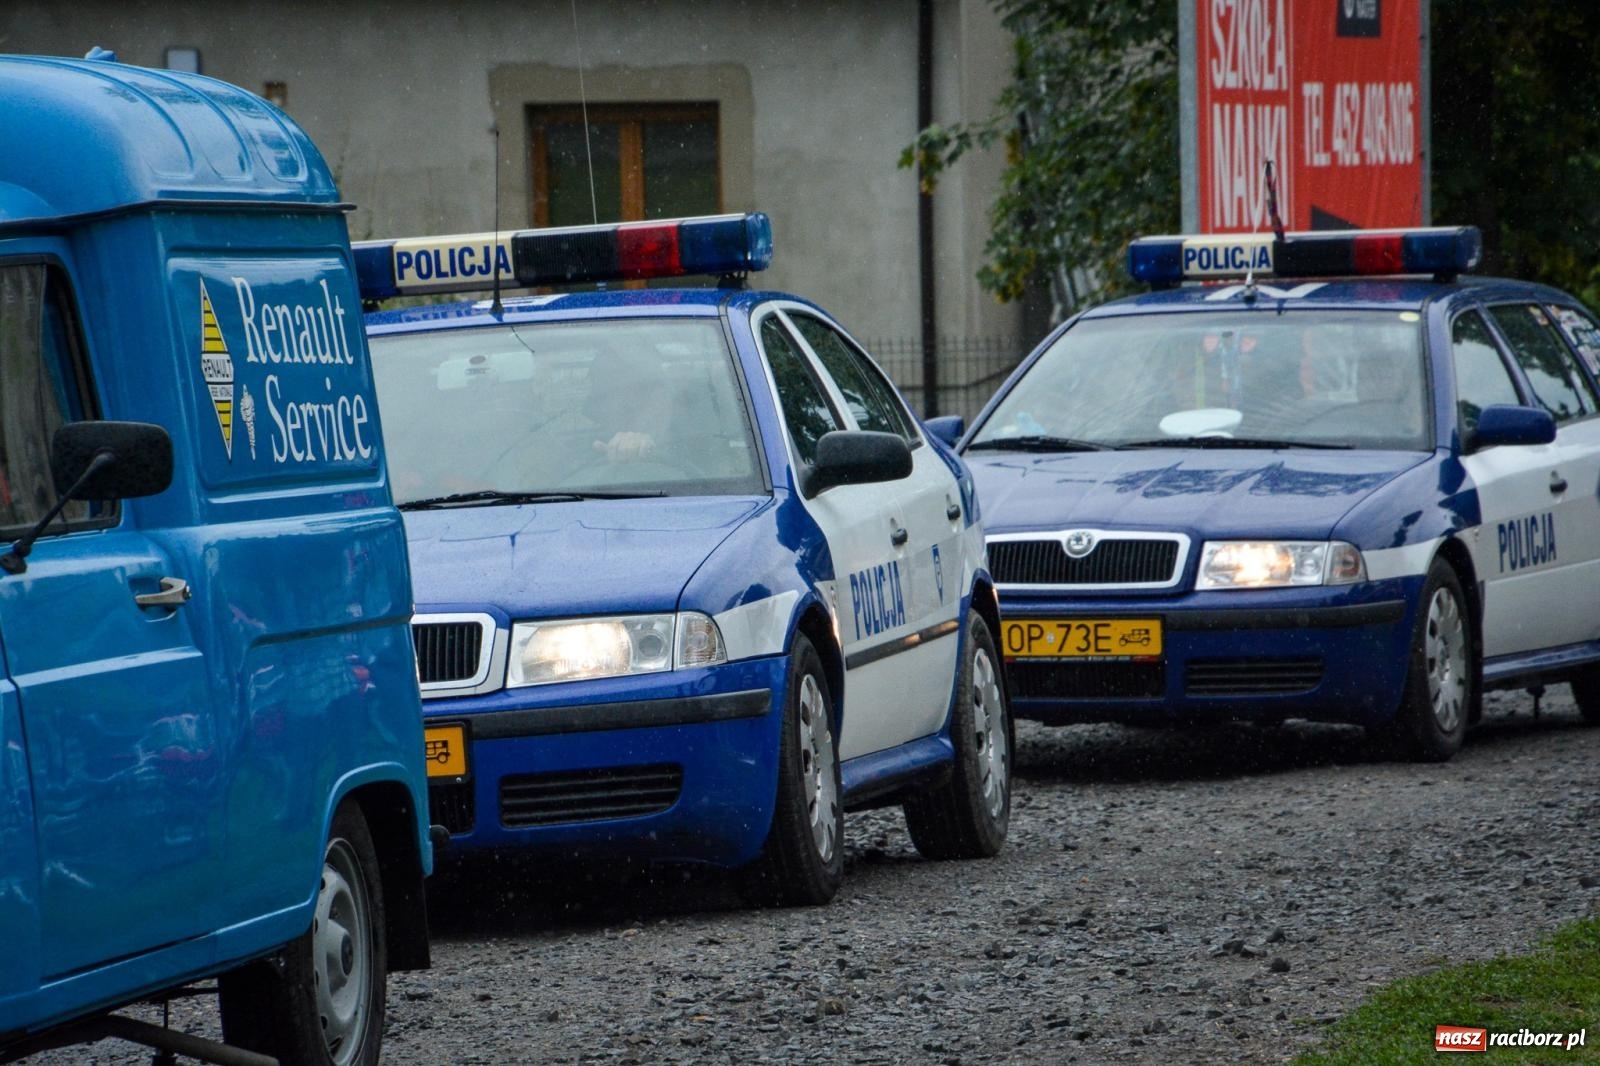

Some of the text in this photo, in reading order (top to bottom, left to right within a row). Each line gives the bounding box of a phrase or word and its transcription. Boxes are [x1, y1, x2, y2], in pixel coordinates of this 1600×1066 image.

[1213, 103, 1288, 229] NAUKI
[396, 244, 512, 283] POLICJA
[231, 277, 354, 364] Renault
[265, 374, 371, 463] Service
[1498, 512, 1557, 573] POLICJA
[850, 560, 906, 640] POLICJA
[1056, 623, 1112, 653] 73E
